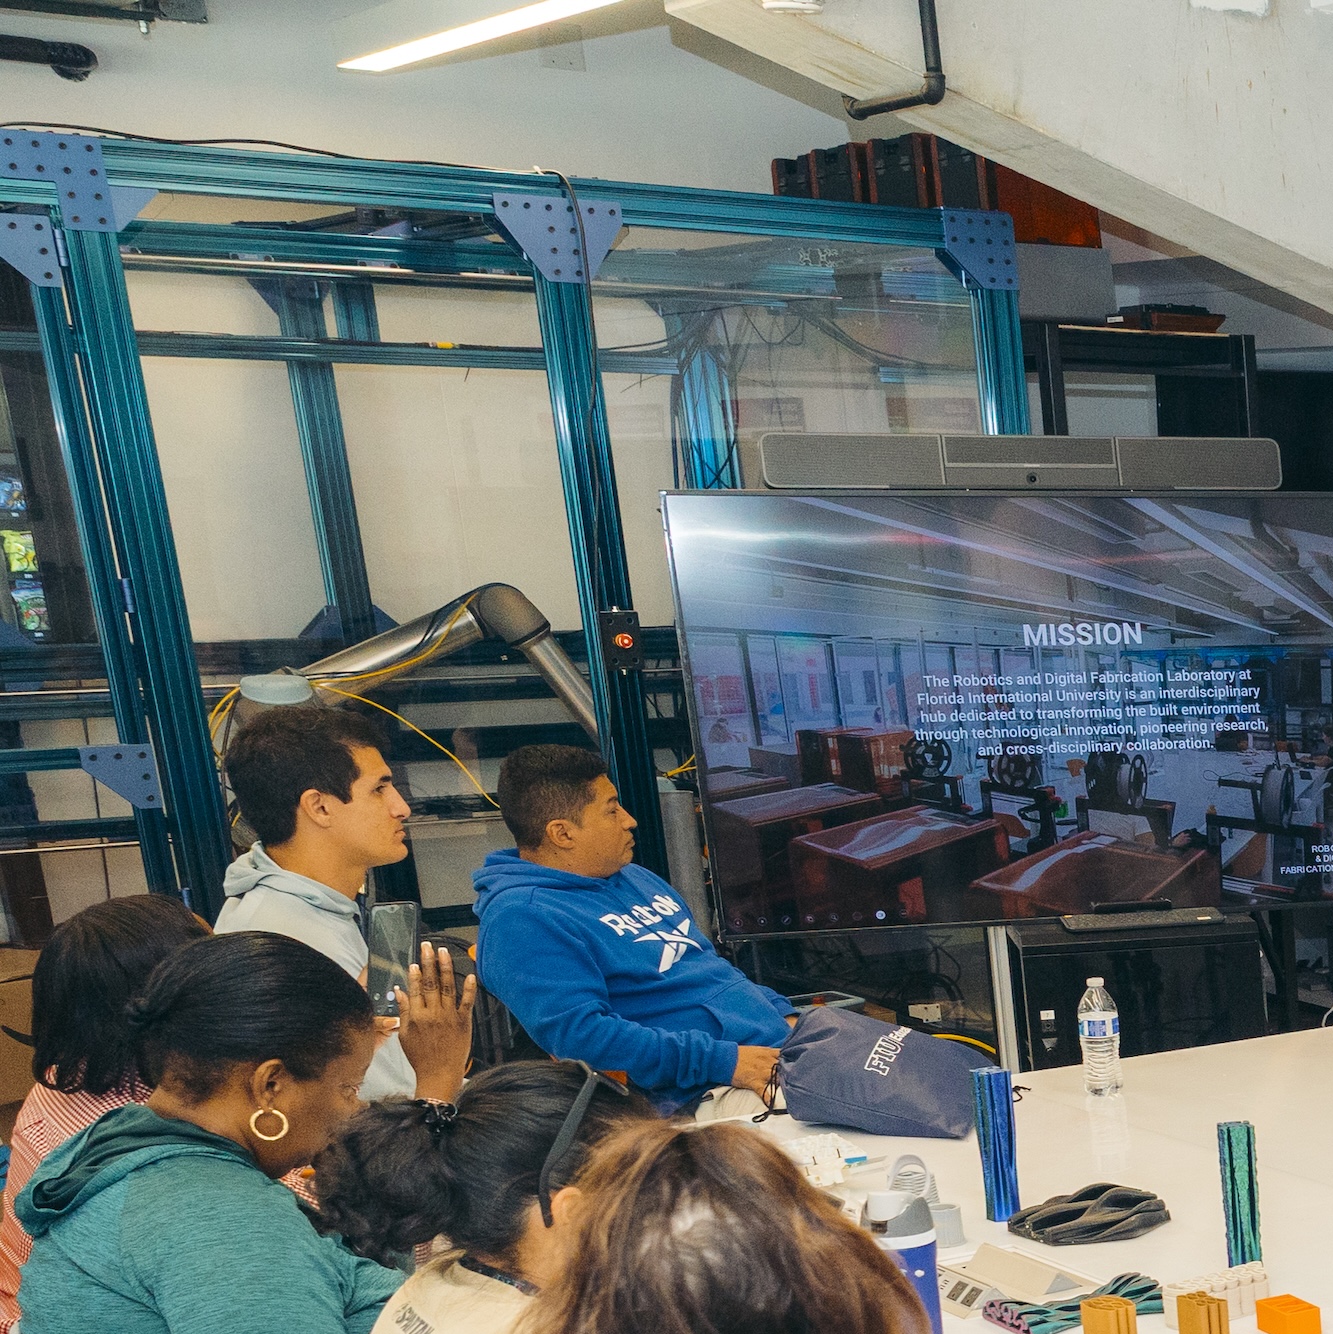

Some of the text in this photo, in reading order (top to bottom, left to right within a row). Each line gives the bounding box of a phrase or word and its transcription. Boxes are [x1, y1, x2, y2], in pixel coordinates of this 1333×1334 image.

[1023, 622, 1143, 647] MISSION
[924, 669, 1252, 688] The Robotics and Digital Fabrication Laboratory at
[917, 686, 1261, 705] Florida International University is an interdisciplinary
[920, 703, 1261, 724] hub dedicated to transforming the built environment
[914, 719, 1269, 743] through technological innovation, pioneering research,
[978, 737, 1214, 757] and cross-disciplinary collaboration.
[599, 894, 681, 936] Reebok
[864, 1034, 905, 1076] FIU
